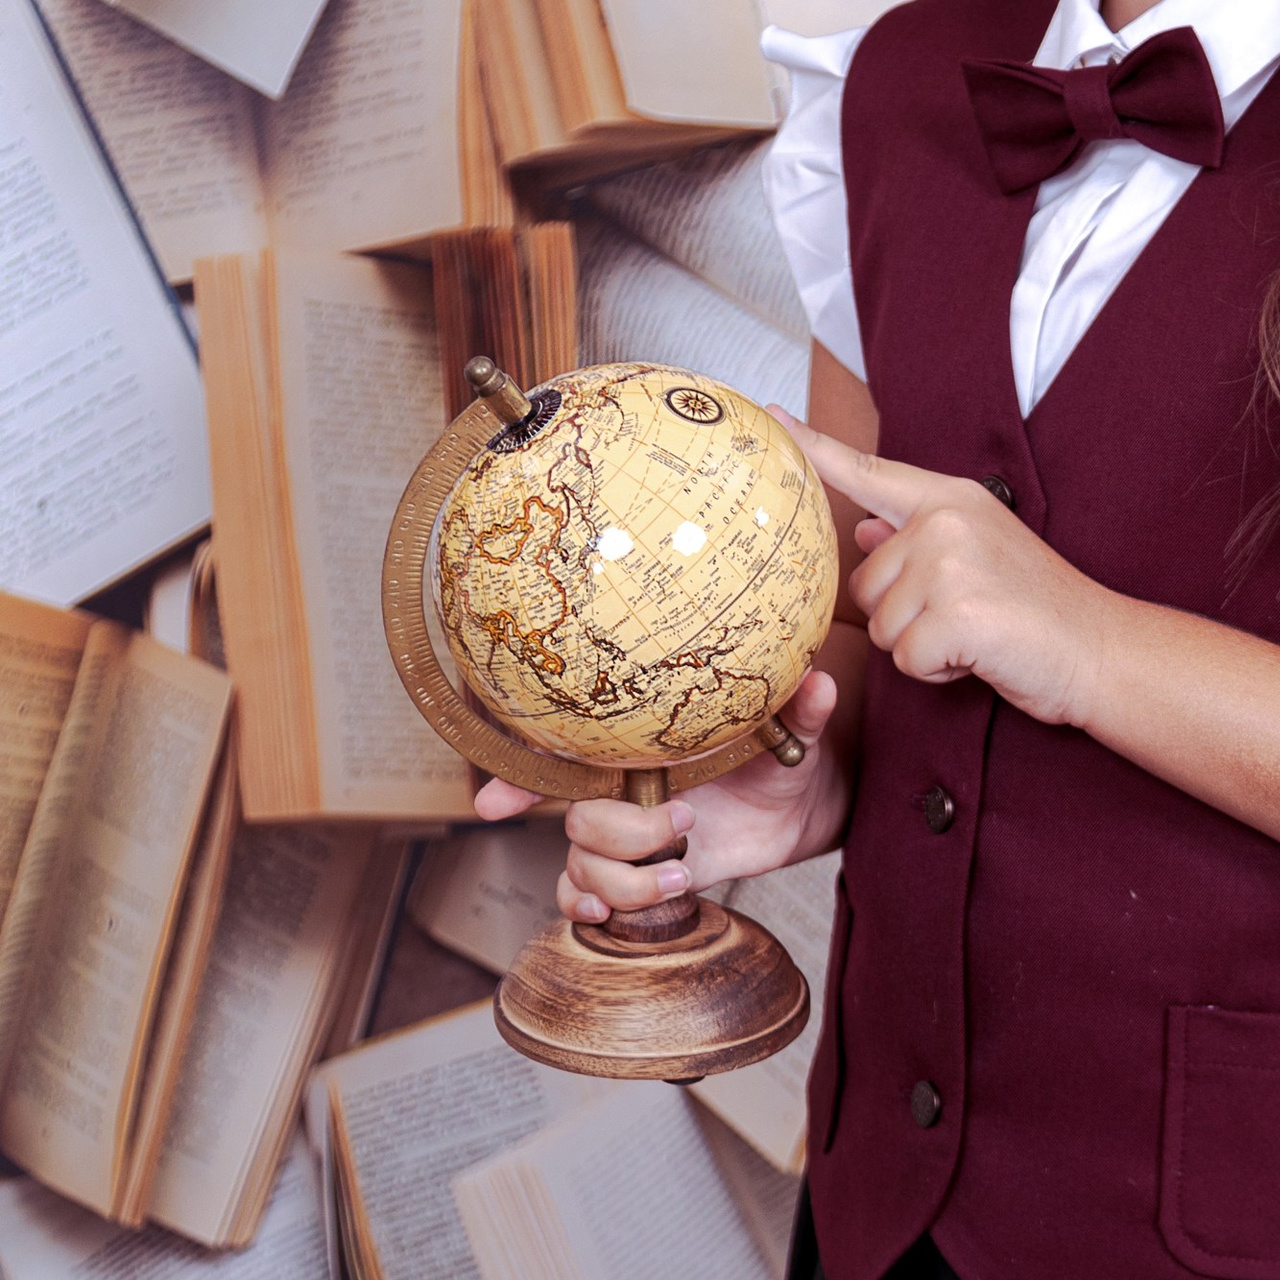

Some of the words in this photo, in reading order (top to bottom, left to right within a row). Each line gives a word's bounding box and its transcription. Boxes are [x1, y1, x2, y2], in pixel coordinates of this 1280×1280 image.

[683, 451, 714, 495] NORTH
[698, 460, 740, 519] PACIFIC
[722, 481, 754, 525] OCEAN
